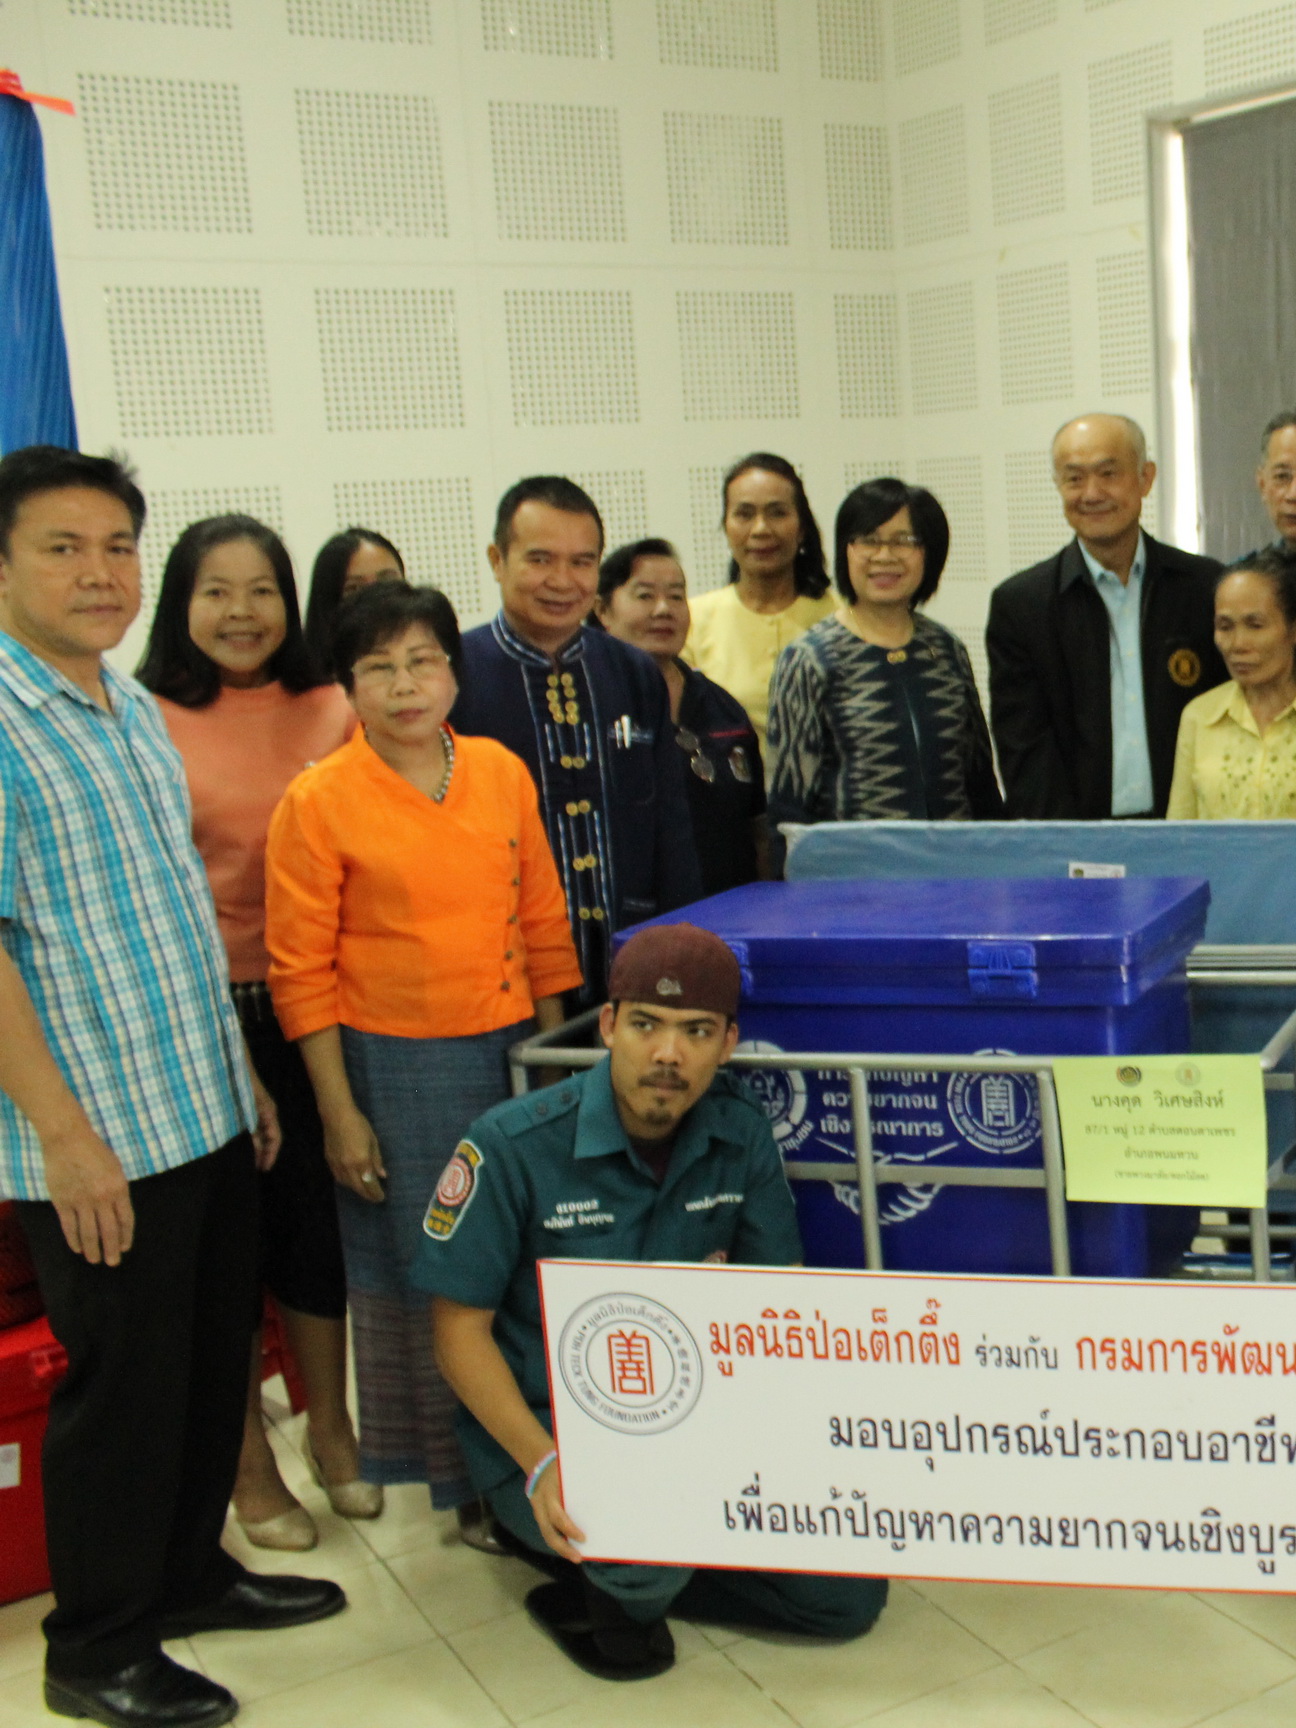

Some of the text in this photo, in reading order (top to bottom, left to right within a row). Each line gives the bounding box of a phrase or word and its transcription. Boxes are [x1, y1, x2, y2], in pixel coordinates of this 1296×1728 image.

[709, 1298, 961, 1377] มูลนิธิป่อเต็กตึ๊ง
[975, 1335, 1059, 1371] ร่วมกับ
